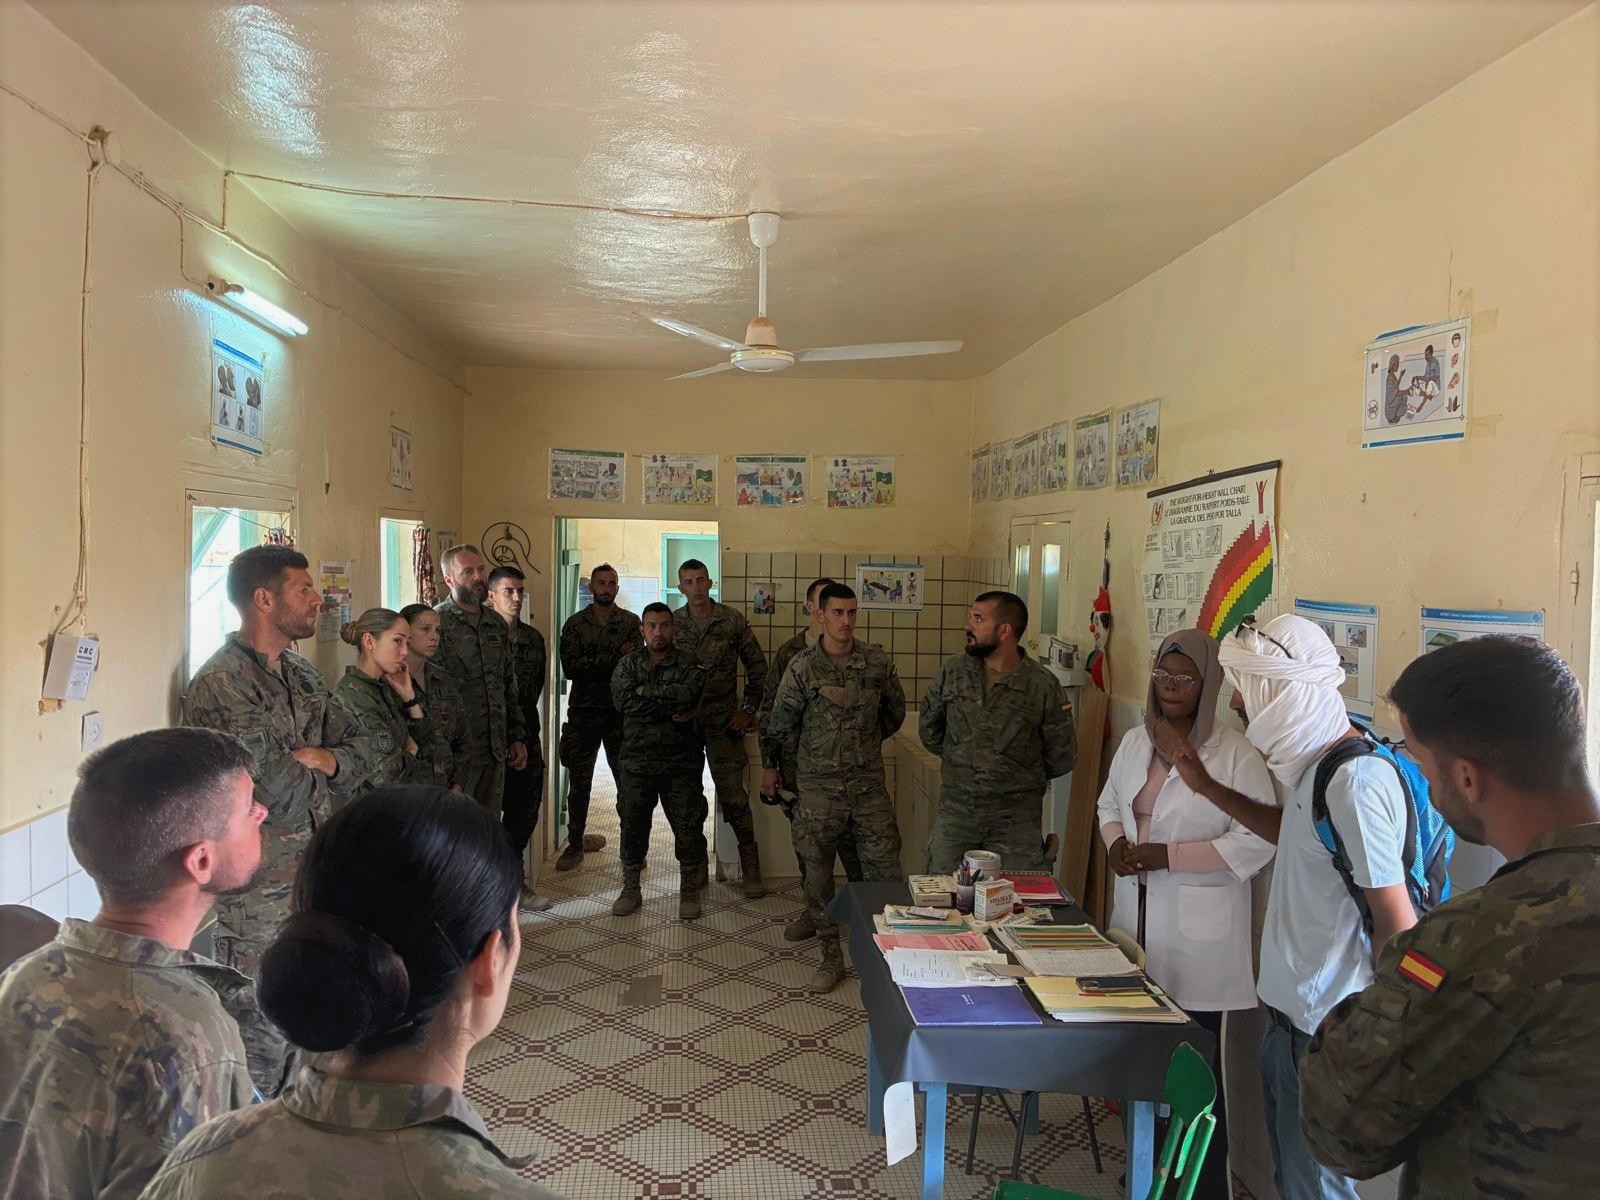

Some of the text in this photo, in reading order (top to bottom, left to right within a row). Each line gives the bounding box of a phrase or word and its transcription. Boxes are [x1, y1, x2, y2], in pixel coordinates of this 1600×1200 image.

[1229, 485, 1246, 495] CHART
[1193, 503, 1202, 512] DU
[1197, 513, 1206, 522] DEL
[1215, 510, 1225, 519] POR
[1225, 508, 1242, 517] TALLA
